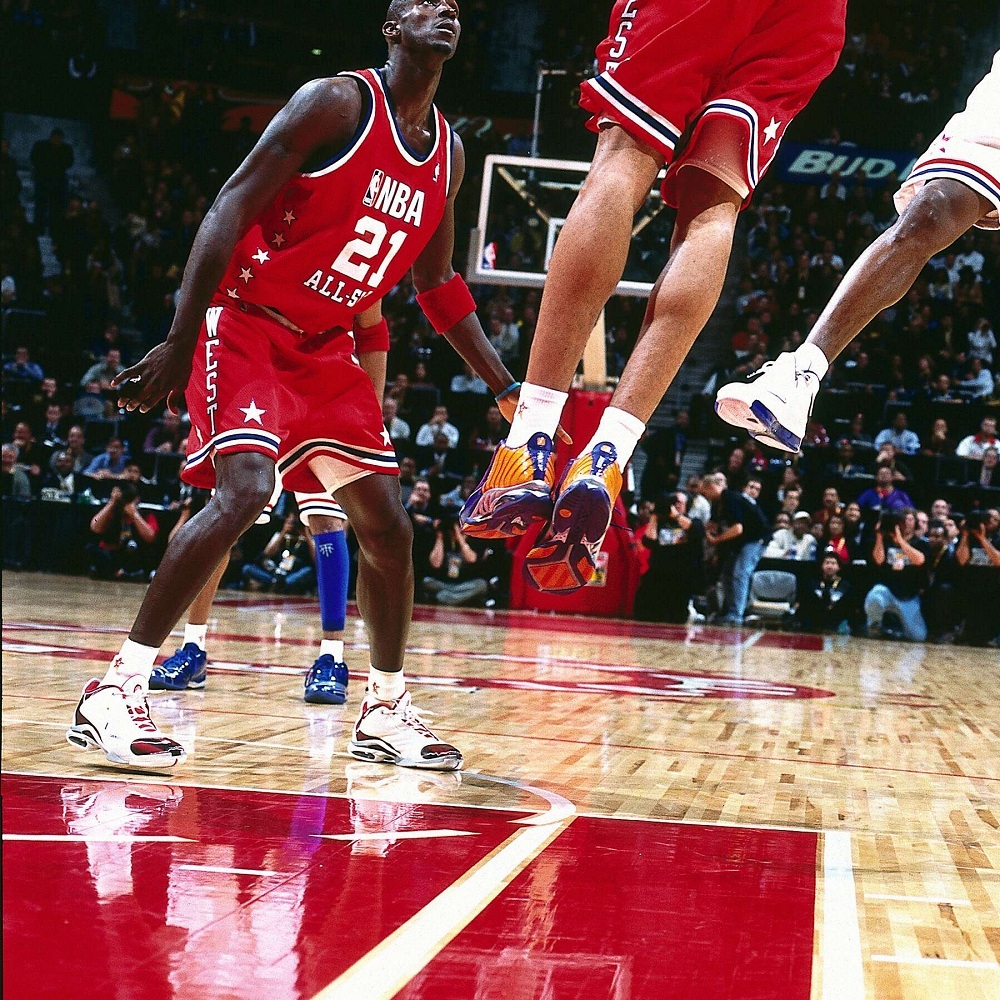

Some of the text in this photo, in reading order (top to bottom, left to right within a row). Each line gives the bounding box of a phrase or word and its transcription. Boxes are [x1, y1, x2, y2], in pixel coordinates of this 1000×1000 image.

[374, 175, 426, 228] NBA
[330, 215, 409, 289] 21
[204, 306, 224, 436] WEST
